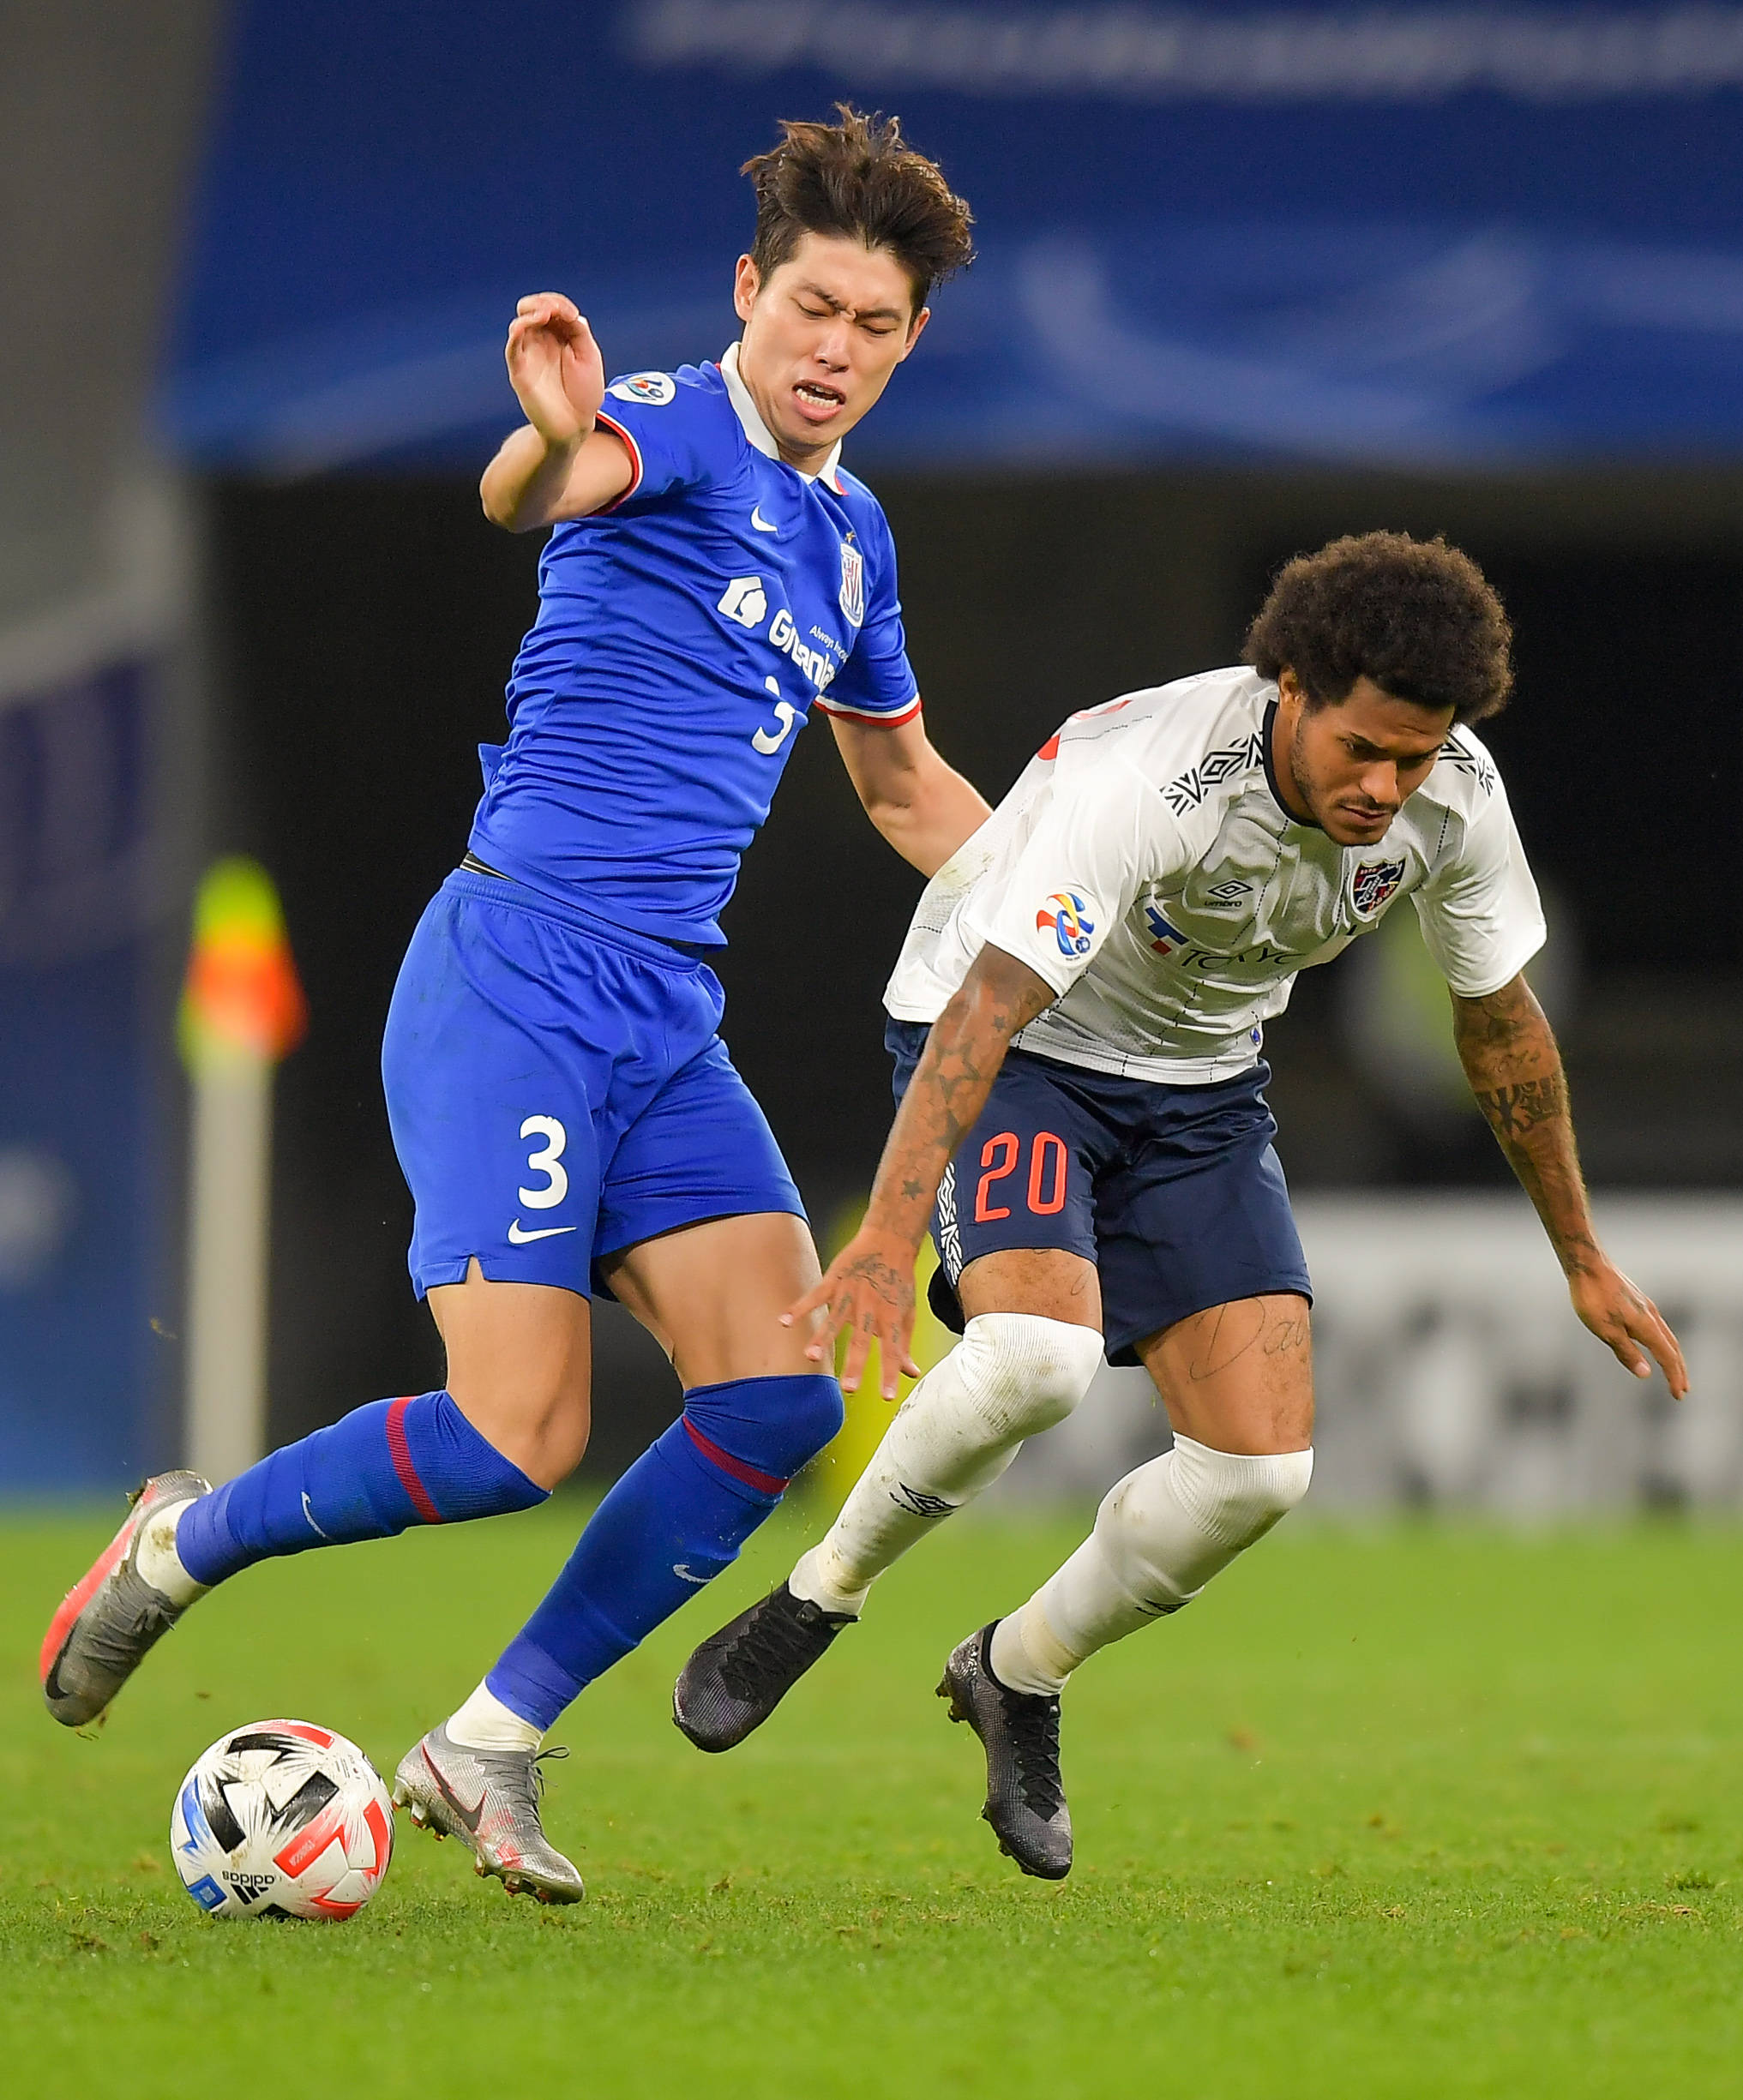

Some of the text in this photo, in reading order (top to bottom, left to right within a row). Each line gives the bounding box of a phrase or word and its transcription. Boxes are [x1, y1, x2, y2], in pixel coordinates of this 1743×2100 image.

[752, 675, 797, 754] 3
[1204, 900, 1242, 909] umbro
[1181, 946, 1307, 969] TOYO
[519, 1114, 568, 1210] 3
[974, 1131, 1068, 1222] 20
[221, 1870, 275, 1887] adidas
